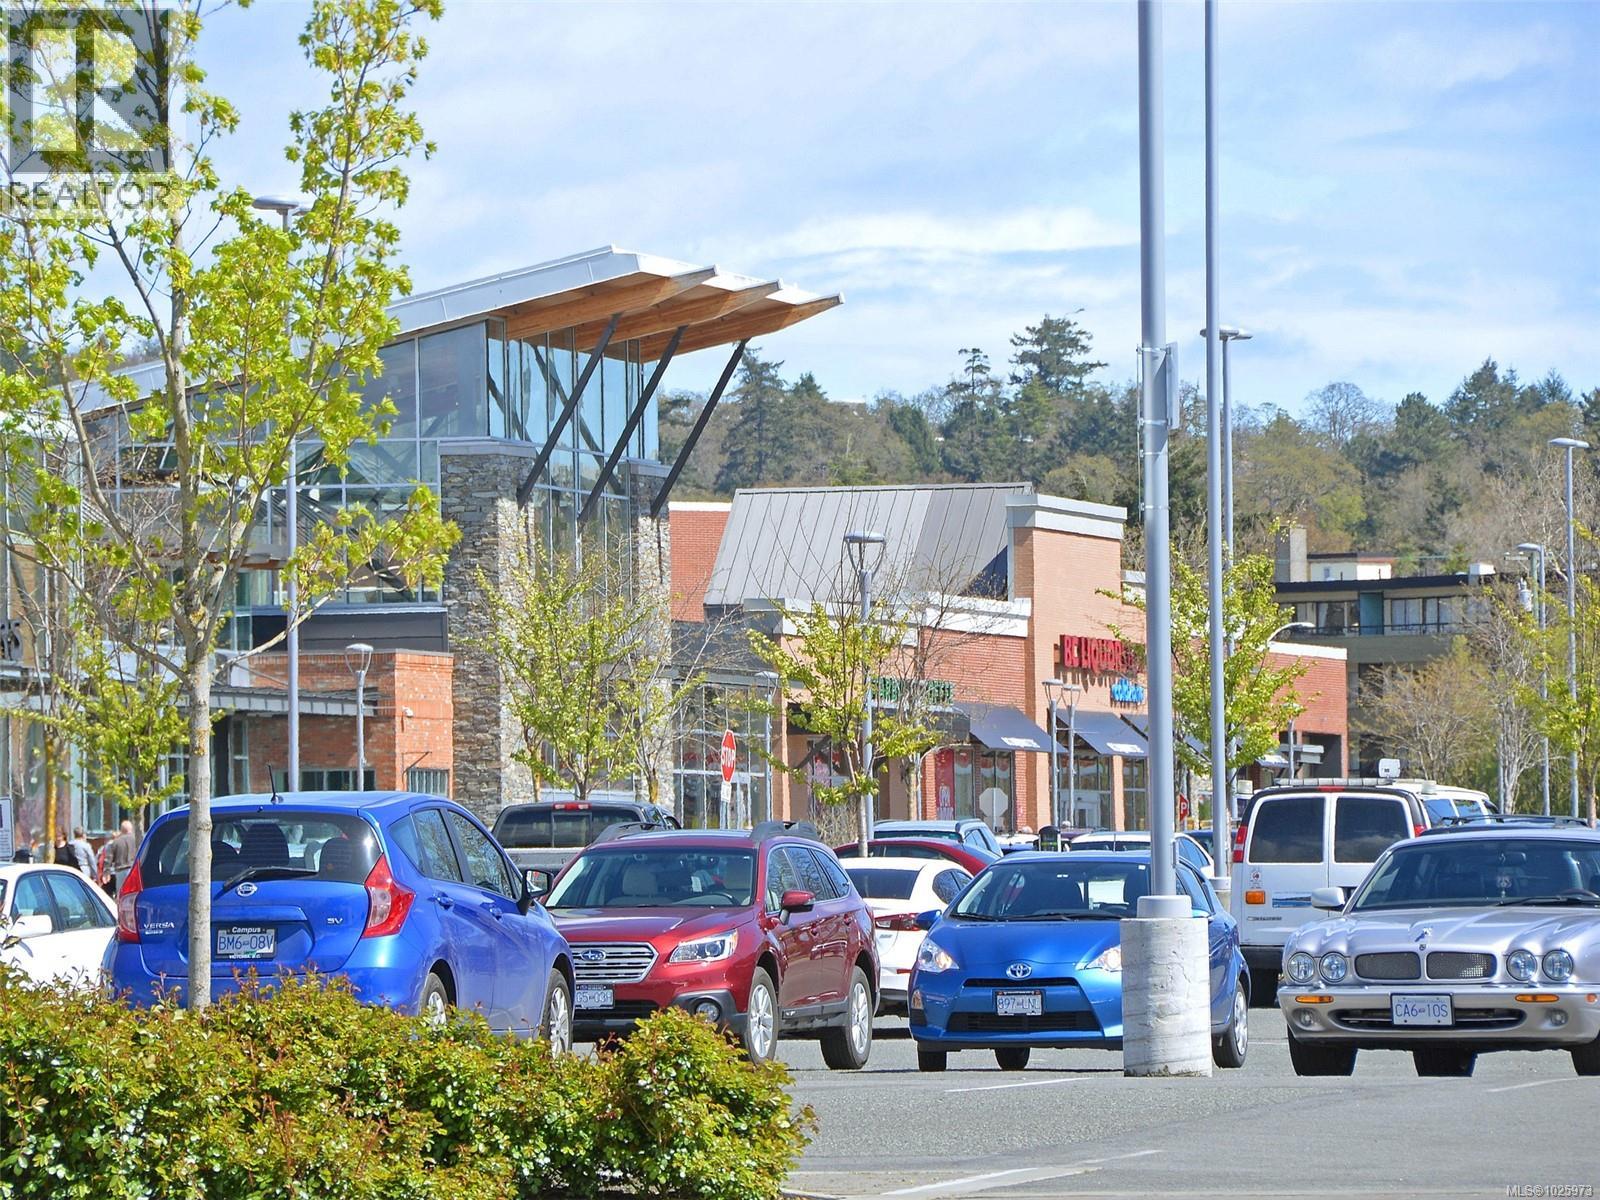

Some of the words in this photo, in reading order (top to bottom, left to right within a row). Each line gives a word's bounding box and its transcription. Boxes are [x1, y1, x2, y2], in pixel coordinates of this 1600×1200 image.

[1063, 635, 1080, 668] BC
[721, 746, 736, 768] STOP
[143, 921, 175, 929] VERSA
[231, 926, 262, 934] Campus
